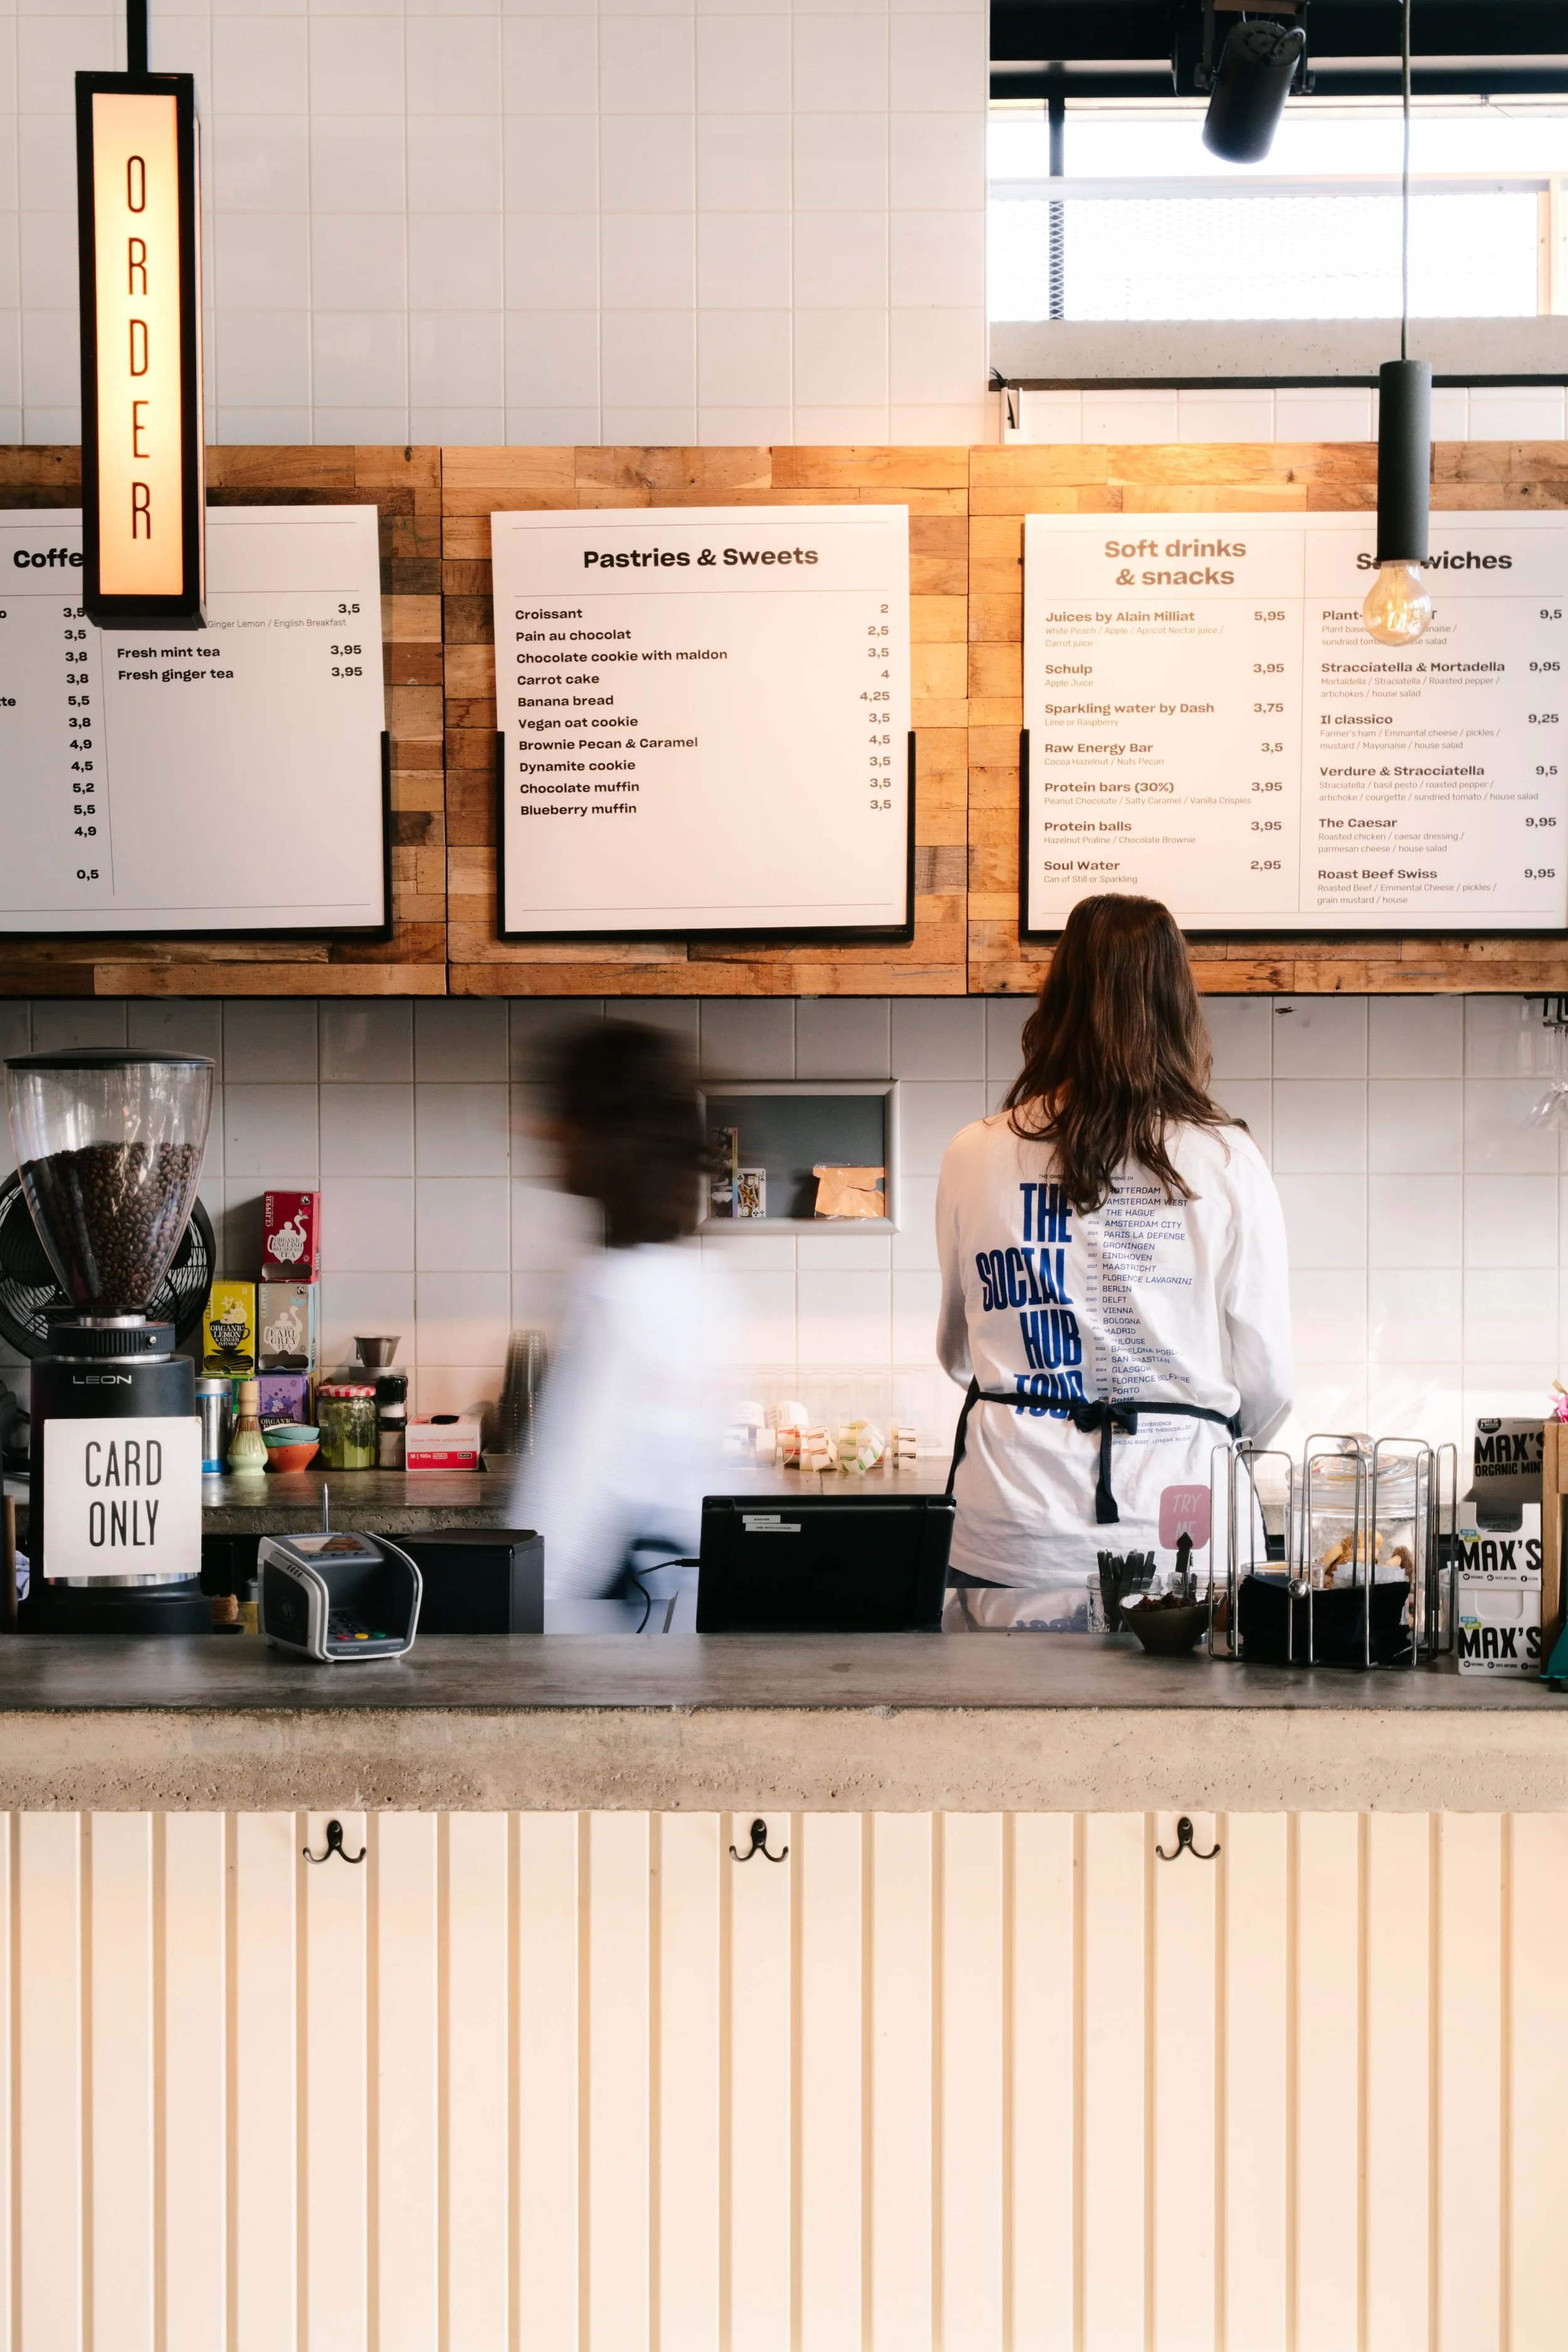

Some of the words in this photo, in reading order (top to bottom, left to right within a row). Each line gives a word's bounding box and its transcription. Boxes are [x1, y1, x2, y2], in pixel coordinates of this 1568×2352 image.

[127, 155, 151, 540] ORDER
[1104, 539, 1158, 558] Soft
[1165, 538, 1246, 557] drinks
[14, 548, 83, 568] Coffe
[584, 548, 690, 568] Pastries
[697, 549, 716, 566] &
[723, 548, 818, 565] Sweets
[1356, 551, 1513, 570] Swiches
[1115, 568, 1135, 585] &
[1142, 567, 1234, 585] snacks
[339, 604, 360, 615] 3,5
[881, 604, 888, 613] 2
[516, 609, 582, 620] Croissant
[1046, 612, 1092, 622] Juices
[1096, 612, 1112, 624] by
[1116, 612, 1150, 622] Alain
[1154, 611, 1195, 621] Milliat
[1254, 611, 1285, 622] 5,95
[1540, 610, 1562, 620] 9,5
[208, 620, 235, 630] Ginger
[274, 619, 304, 628] English
[307, 618, 346, 627] Breakfast
[65, 630, 86, 641] 3,5
[516, 631, 545, 641] Pain
[549, 633, 565, 641] au
[569, 630, 631, 640] chocolat
[868, 626, 889, 637] 2,5
[117, 647, 157, 658] Fresh
[161, 647, 193, 657] mint
[196, 647, 220, 657] tea
[331, 645, 361, 656] 3,95
[868, 648, 889, 659] 3,5
[65, 652, 87, 664] 3,8
[517, 652, 587, 664] Chocolate
[591, 651, 638, 662] cookie
[642, 650, 672, 660] with
[676, 650, 727, 660] maldon
[332, 667, 362, 678] 3,95
[1046, 664, 1093, 676] Schulp
[1253, 664, 1284, 674] 3,95
[1322, 662, 1412, 672] Stracciatella
[1416, 663, 1427, 672] &
[1431, 662, 1505, 672] Mortadella
[1530, 662, 1560, 673] 9,95
[119, 670, 158, 680] Fresh
[162, 669, 206, 682] ginger
[210, 669, 233, 679] tea
[517, 675, 562, 685] Carrot
[566, 674, 600, 684] cake
[881, 670, 889, 679] 4
[1045, 679, 1069, 687] Apple
[518, 697, 569, 707] Banana
[573, 695, 613, 706] bread
[860, 691, 889, 702] 4,25
[1045, 703, 1111, 716] Sparkling
[1114, 704, 1155, 713] water
[1160, 703, 1176, 715] by
[1180, 703, 1214, 712] Dash
[1254, 703, 1283, 714] 3,75
[519, 719, 561, 731] Vegan
[565, 718, 588, 728] oat
[591, 716, 638, 727] cookie
[1077, 719, 1119, 728] Raspberry
[1321, 715, 1330, 724] Il
[1335, 714, 1392, 724] classico
[1528, 714, 1559, 724] 9,25
[70, 739, 92, 751] 4,9
[519, 739, 575, 750] Brownie
[579, 740, 622, 749] Pecan
[625, 739, 636, 748] &
[640, 738, 697, 748] Caramel
[1045, 744, 1074, 753] Raw
[1078, 743, 1126, 755] Energy
[1130, 743, 1153, 753] Bar
[520, 761, 585, 775] Dynamite
[589, 760, 635, 770] cookie
[1320, 766, 1376, 776] Verdure
[1380, 767, 1390, 776] &
[1394, 765, 1484, 776] Stracciatella
[73, 783, 94, 795] 5,2
[521, 783, 590, 793] Chocolate
[595, 781, 639, 792] muffin
[1045, 782, 1095, 792] Protein
[1099, 782, 1131, 792] bars
[1135, 782, 1174, 793] (30%)
[521, 805, 588, 817] Blueberry
[592, 803, 636, 813] muffin
[1045, 821, 1095, 831] Protein
[1099, 822, 1131, 831] balls
[1319, 818, 1344, 827] The
[1348, 818, 1397, 827] Caesar
[1424, 833, 1458, 841] dressing
[1044, 861, 1073, 870] Soul
[1077, 861, 1120, 870] Water
[77, 869, 98, 881] 0,5
[1318, 870, 1358, 879] Roast
[1362, 869, 1394, 879] Beef
[1397, 869, 1438, 879] Swiss
[1100, 876, 1137, 884] Sparkling
[1317, 897, 1338, 906] grain
[1104, 1220, 1158, 1228] AMSTERDAM
[1103, 1242, 1155, 1250] GRONINGEN
[1102, 1253, 1153, 1261] EINDHOVEN
[1103, 1263, 1157, 1272] MAASTRICHT
[975, 1247, 1074, 1311] SOCIAL
[1019, 1309, 1082, 1369] HUB
[73, 1375, 132, 1385] LEON
[85, 1440, 162, 1487] CARD
[1172, 1493, 1202, 1513] TRY
[89, 1500, 159, 1547] ONLY
[1459, 1539, 1541, 1572] MAX'S
[1459, 1626, 1542, 1659] MAX'S
